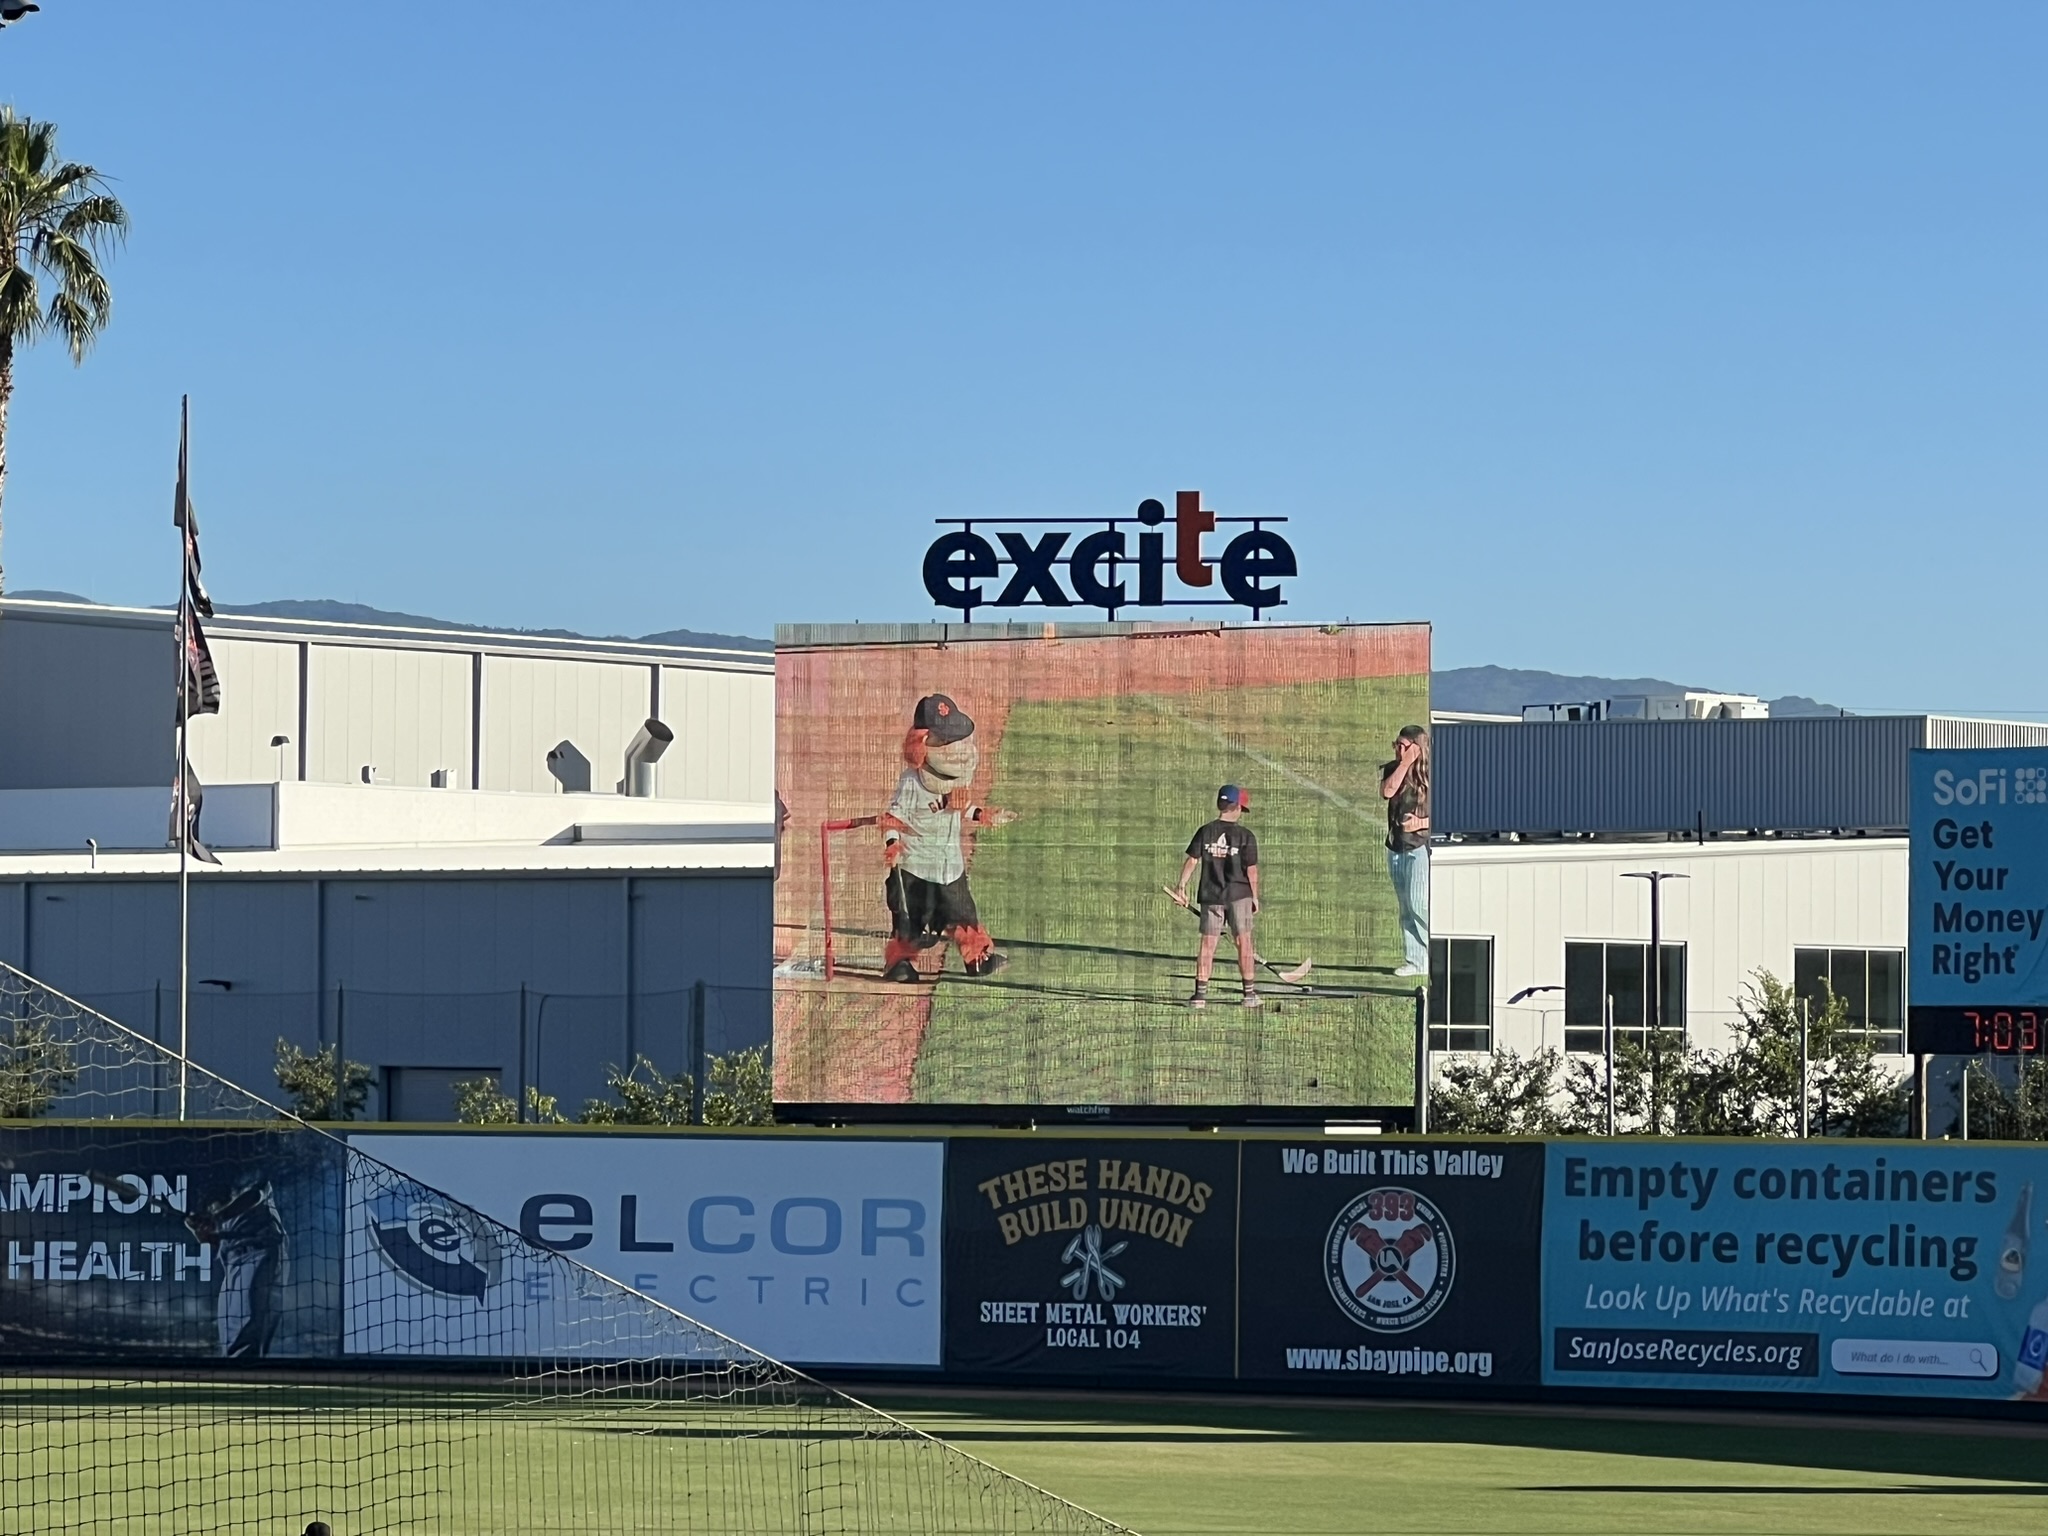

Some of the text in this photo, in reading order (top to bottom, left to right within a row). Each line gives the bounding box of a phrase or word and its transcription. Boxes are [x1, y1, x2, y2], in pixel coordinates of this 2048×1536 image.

[922, 491, 1298, 609] excite
[1933, 768, 2007, 806] SoFi
[1933, 818, 1994, 849] Get
[1933, 860, 2009, 891] Your
[1933, 902, 2045, 941] Money
[1963, 1012, 2038, 1051] 7:03
[1283, 1149, 1504, 1180] We Built This Valley
[1564, 1157, 1997, 1210] Empty containers
[979, 1158, 1213, 1214] THESE HANDS
[996, 1198, 1194, 1248] BUILD UNION
[1368, 1191, 1416, 1221] 393
[8, 1241, 212, 1281] HEALTH
[1579, 1219, 1978, 1281] before recycling
[980, 1301, 1207, 1327] SHEET METAL WORKERS'
[1585, 1283, 1971, 1322] Look Up What's Recyclable at
[1046, 1327, 1141, 1350] LOCAL 104
[1569, 1336, 1803, 1369] SanJoseRecycles.org
[1286, 1346, 1493, 1377] www.sbaypipe.org
[1850, 1352, 1877, 1363] What
[1880, 1353, 1894, 1363] do
[1903, 1353, 1915, 1364] do
